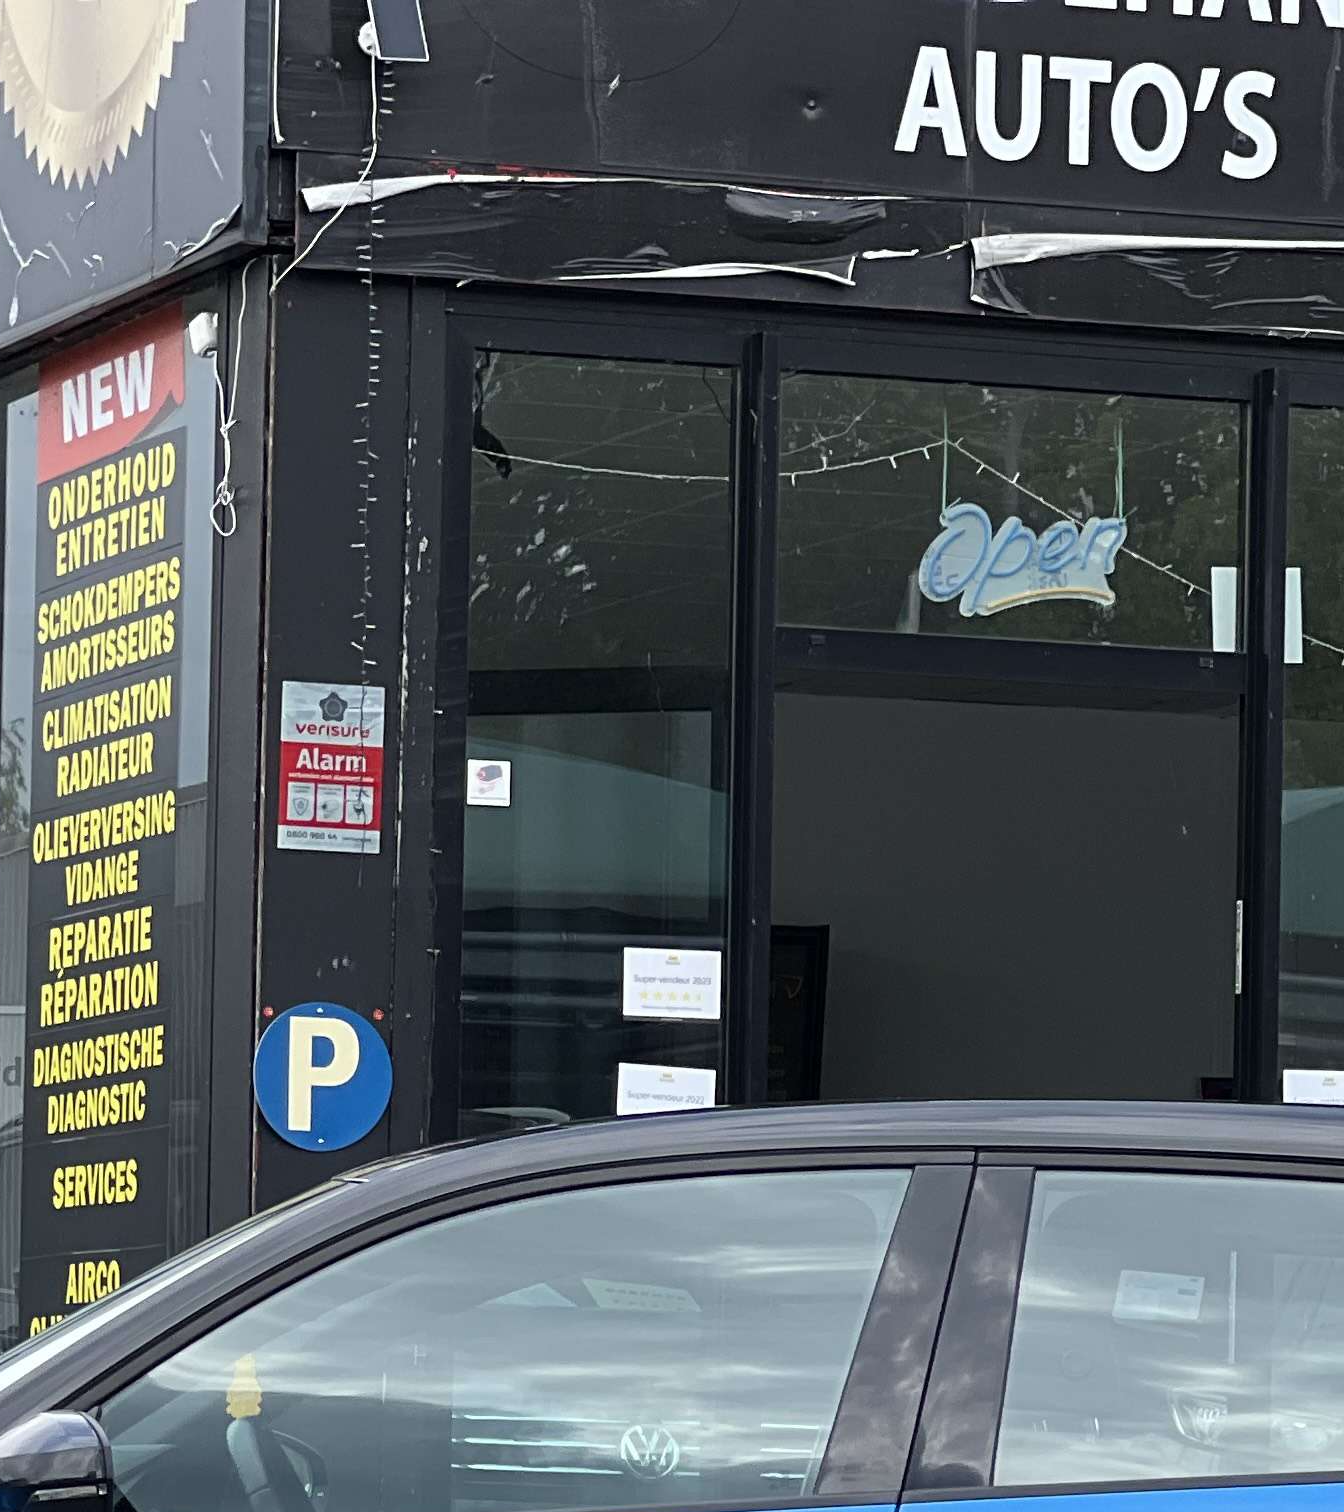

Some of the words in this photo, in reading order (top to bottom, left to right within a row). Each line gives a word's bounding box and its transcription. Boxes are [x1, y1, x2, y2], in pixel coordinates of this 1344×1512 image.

[893, 45, 1278, 181] AUTO'S
[61, 343, 155, 444] NEW
[47, 442, 177, 530] ONDERHOUD
[56, 496, 166, 577] ENTRETIEN
[924, 503, 1125, 613] Open
[37, 556, 181, 645] SCHOKDEMPERS
[40, 609, 176, 694] AMORTISSEURS
[42, 674, 172, 752] CLIMATISATION
[295, 722, 371, 739] verisure
[57, 731, 154, 797] RADIATEUR
[296, 747, 367, 774] Alarm
[32, 790, 176, 864] OLIEVERVERSING
[65, 850, 139, 906] VIDANGE
[49, 905, 153, 971] REPARATIE
[40, 960, 159, 1028] RÉPARATION
[33, 1024, 165, 1088] DIAGNOSTISCHE
[287, 1015, 361, 1132] P
[47, 1080, 146, 1135] DIAGNOSTIC
[52, 1159, 139, 1210] SERVICES
[65, 1259, 121, 1305] AIRCO
